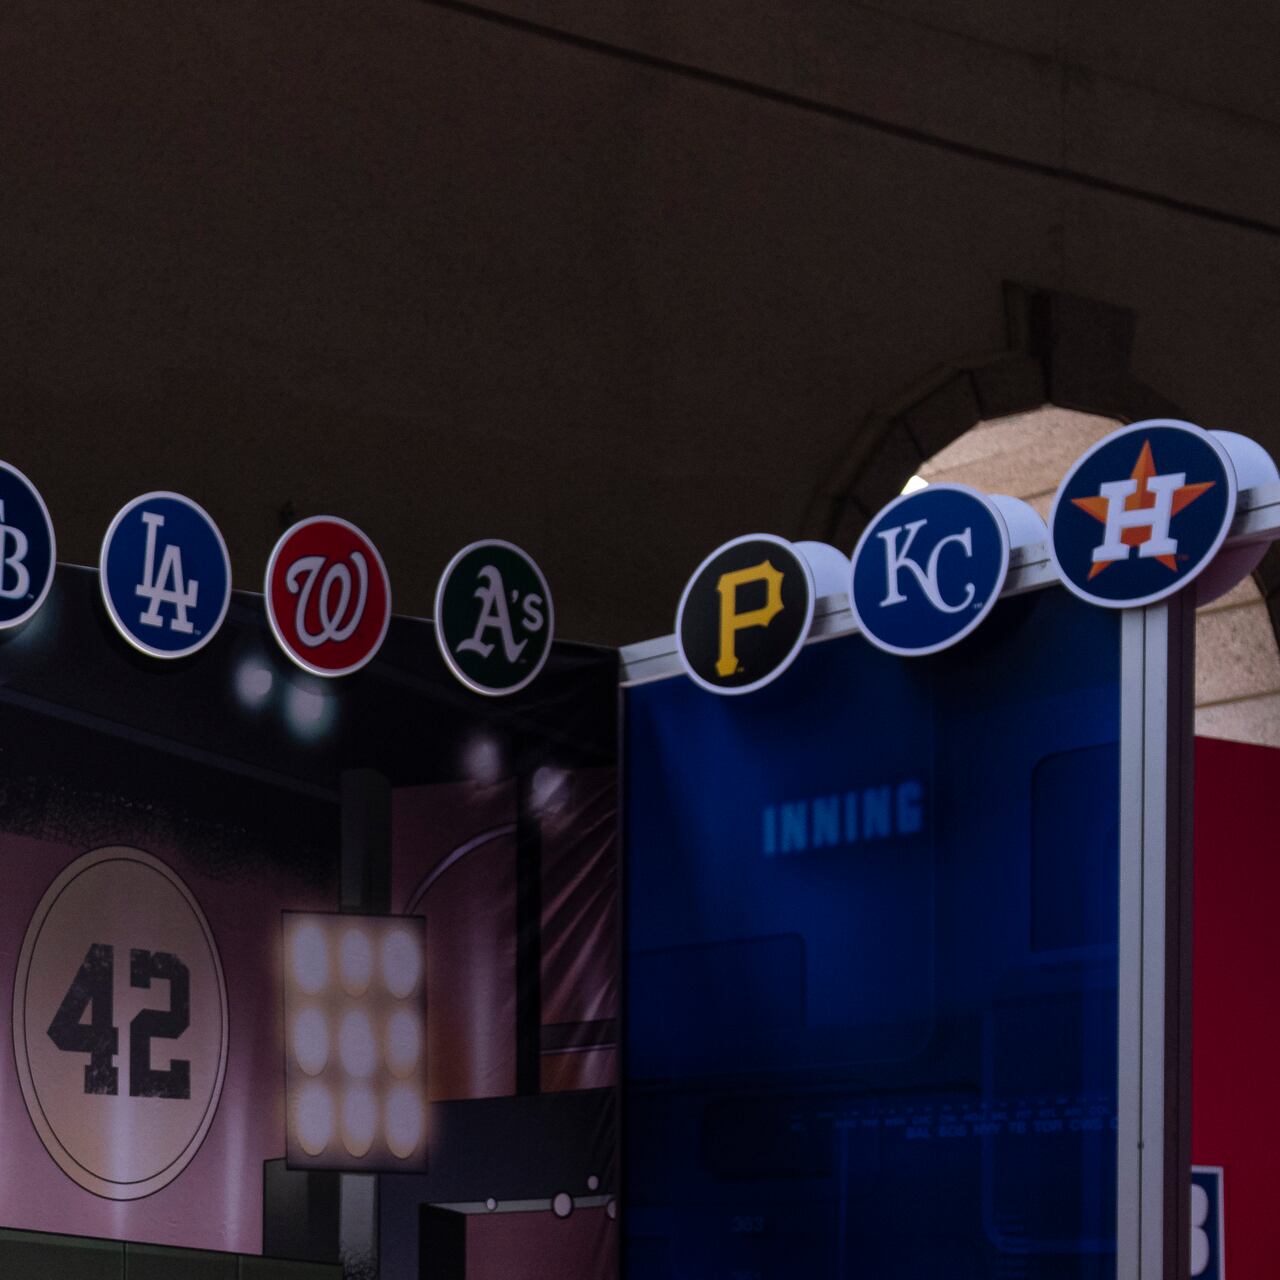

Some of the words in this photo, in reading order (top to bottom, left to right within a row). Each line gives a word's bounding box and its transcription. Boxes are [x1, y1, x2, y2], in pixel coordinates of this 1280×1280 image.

[1090, 472, 1186, 563] H
[135, 512, 198, 635] LA
[285, 551, 368, 647] W
[456, 565, 543, 664] A's
[876, 519, 976, 614] KC
[714, 559, 786, 677] P
[763, 780, 923, 855] INNING
[44, 941, 193, 1100] 42
